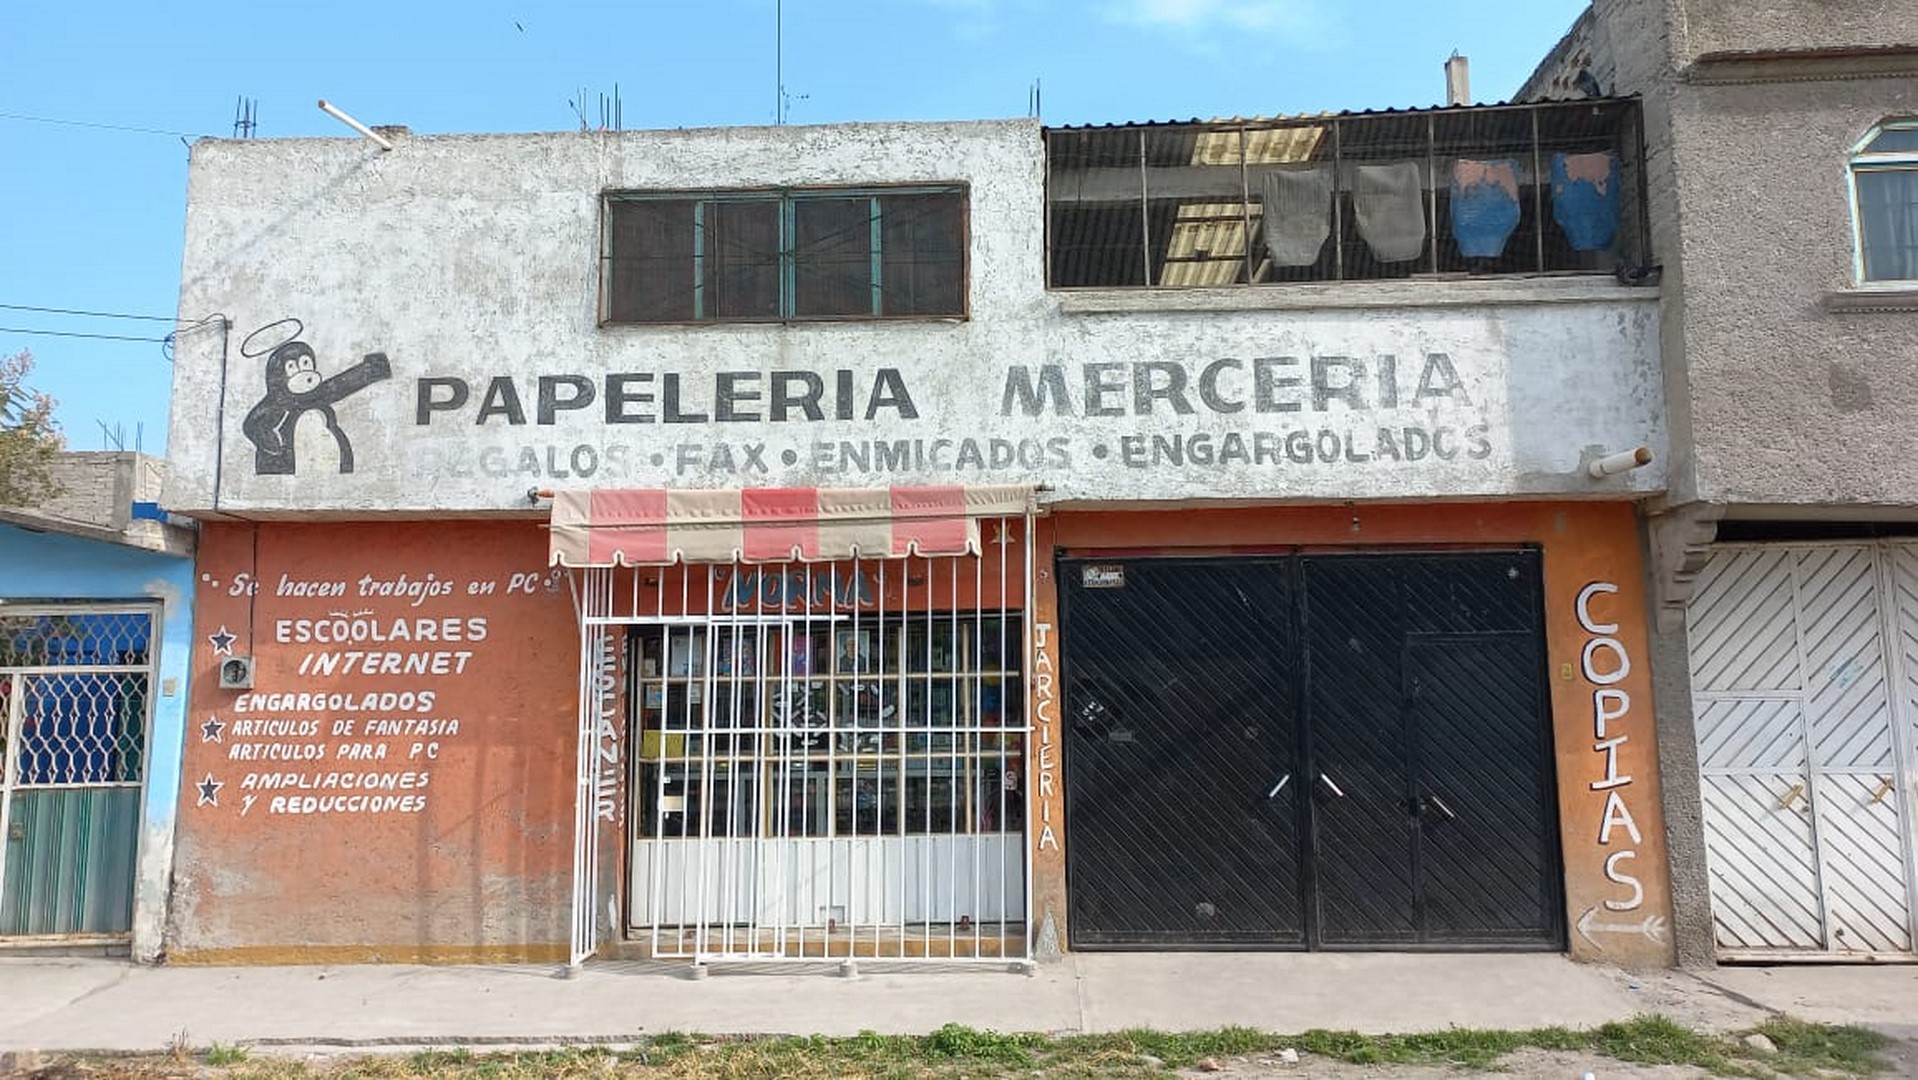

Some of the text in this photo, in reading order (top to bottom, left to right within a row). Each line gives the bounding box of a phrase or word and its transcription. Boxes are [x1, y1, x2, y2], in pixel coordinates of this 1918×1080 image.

[416, 352, 1473, 426] PAPELERIA MERCERIA
[676, 442, 770, 478] FAX
[813, 437, 1072, 476] ENMICADOS
[228, 572, 540, 606] Se hacen trabajos en PC
[298, 651, 473, 676] INTERNET
[233, 691, 436, 713] ENGARGOLADOS
[231, 718, 460, 736] ARTICULOS DE FANTASIA
[1035, 622, 1059, 851] JARCIERIA
[228, 742, 439, 761] ARTICULOS PARA PC
[1575, 581, 1644, 911] COPIAS
[241, 772, 430, 790] AMPLIACIONES
[269, 794, 427, 814] REDUCCIONES
